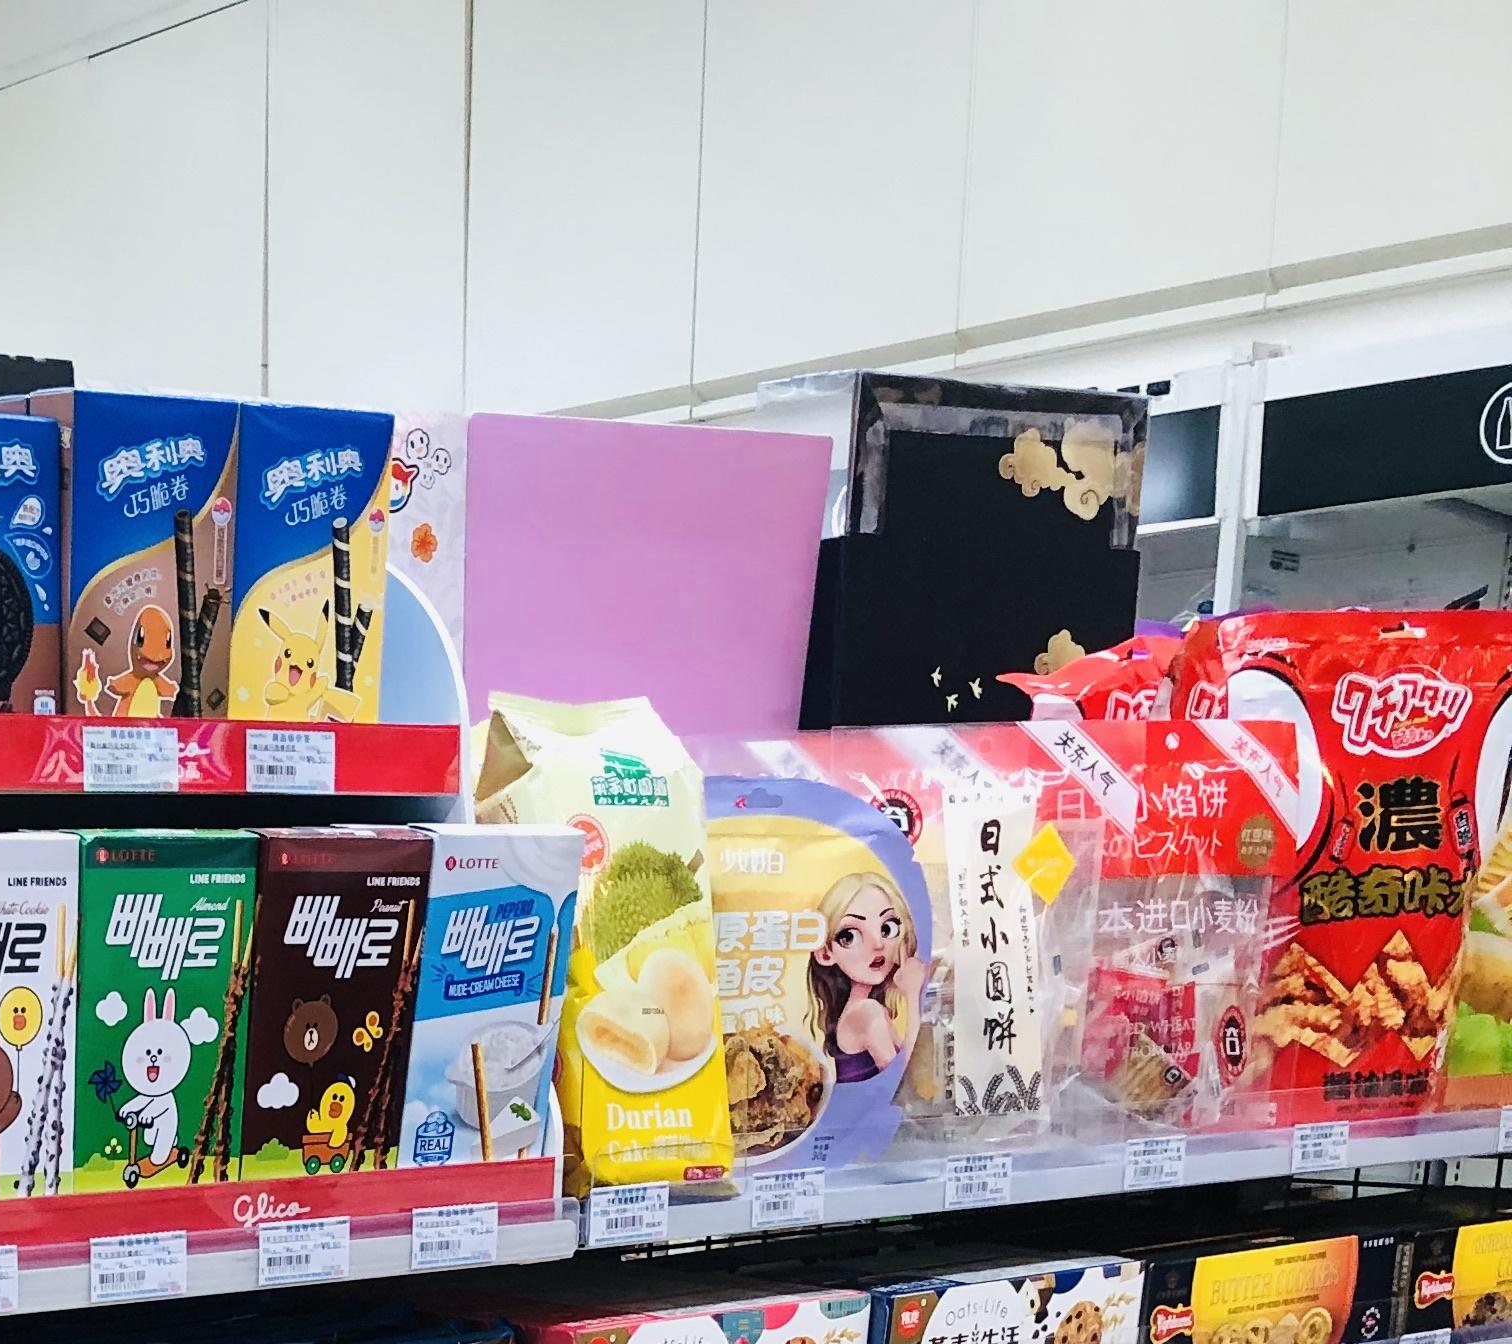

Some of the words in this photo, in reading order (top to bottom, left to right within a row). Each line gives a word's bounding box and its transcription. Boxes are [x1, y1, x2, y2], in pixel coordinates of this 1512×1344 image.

[101, 437, 205, 494] 奥利奥
[264, 446, 364, 500] 奥利奥
[1052, 729, 1119, 797] 关东人气
[1358, 776, 1443, 852] 濃
[459, 856, 500, 870] LOTTE
[7, 876, 28, 888] LINE
[30, 875, 68, 887] FRIENDS
[190, 897, 229, 914] Almond
[370, 899, 403, 915] Peanut
[105, 893, 227, 980] 빼빼로
[284, 893, 399, 979] 빼빼로
[442, 904, 541, 975] 빼빼로
[607, 1103, 694, 1131] Durian
[418, 1135, 450, 1153] REAL
[233, 1194, 312, 1223] Glico
[945, 1301, 1011, 1327] Oats-Life
